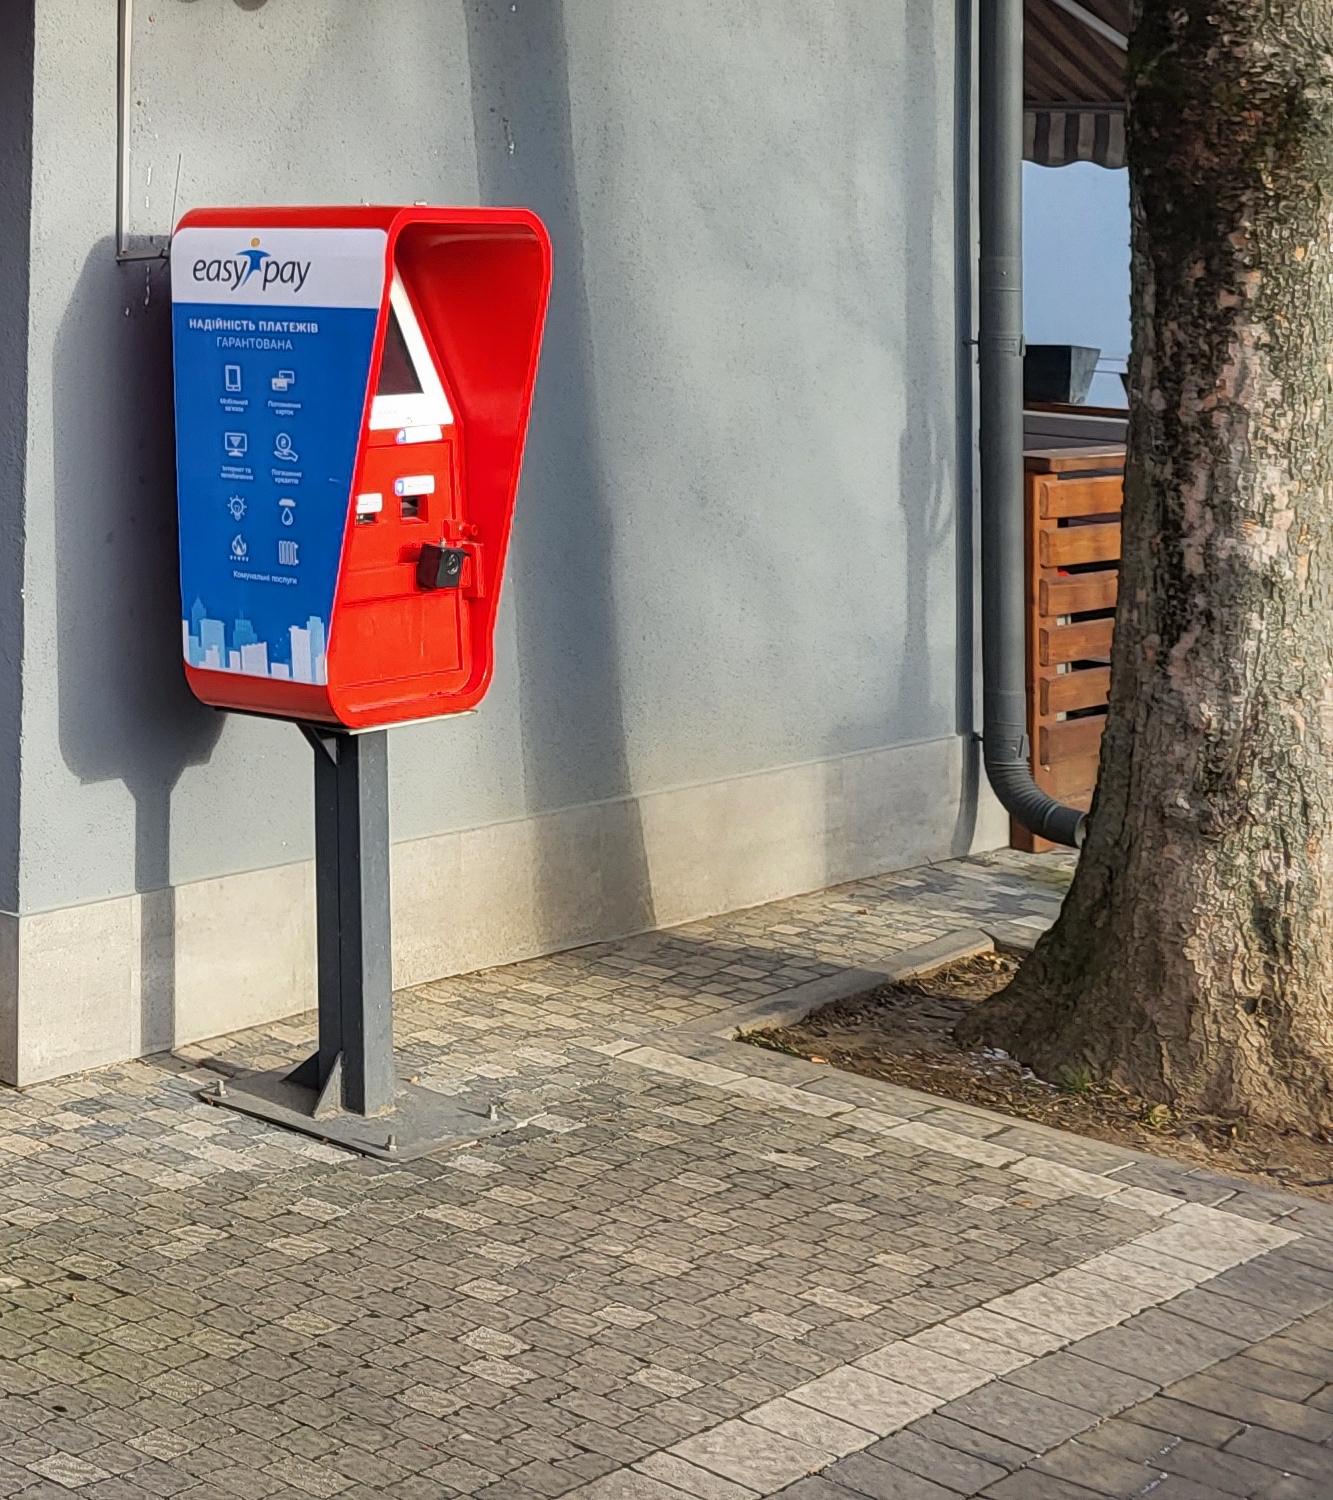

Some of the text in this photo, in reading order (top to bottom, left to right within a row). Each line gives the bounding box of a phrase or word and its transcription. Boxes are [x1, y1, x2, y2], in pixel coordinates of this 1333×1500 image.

[189, 317, 319, 334] НАДІЙНІСТЬ ПЛАТЕЖІВ
[216, 336, 293, 351] ГАРАНТОВАНА
